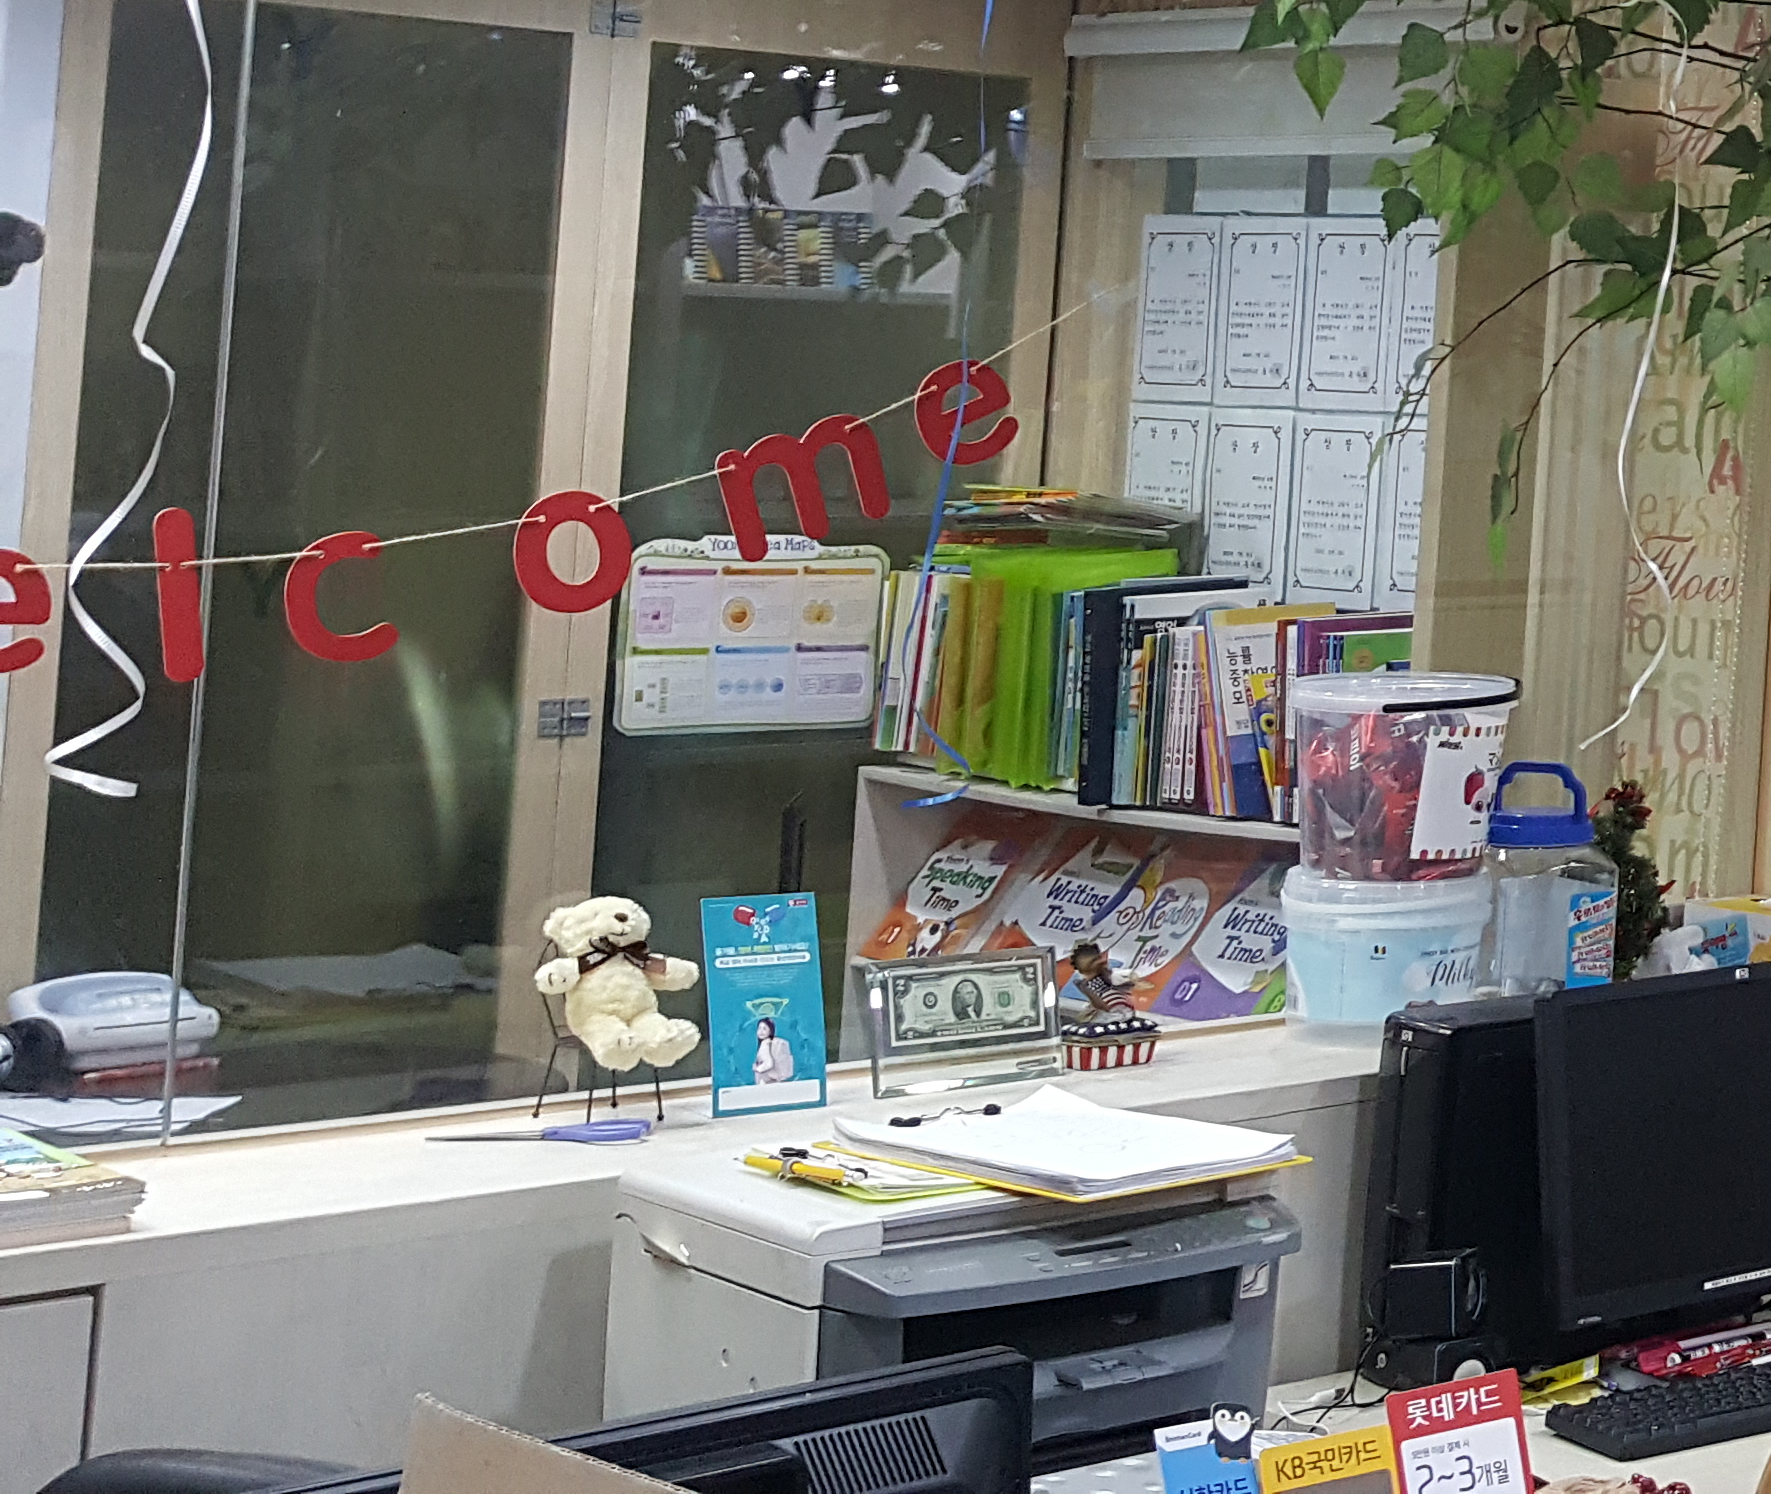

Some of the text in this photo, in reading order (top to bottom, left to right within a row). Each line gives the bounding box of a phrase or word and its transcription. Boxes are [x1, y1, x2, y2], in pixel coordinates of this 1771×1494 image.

[921, 857, 998, 898] Speaking
[1046, 877, 1111, 913] Writing
[924, 886, 960, 912] Time
[1039, 905, 1086, 933] Time
[1222, 906, 1288, 944] Writing
[1217, 934, 1266, 964] Time
[1406, 1383, 1503, 1430] 롯데카드
[1275, 1439, 1382, 1483] KB국민카드
